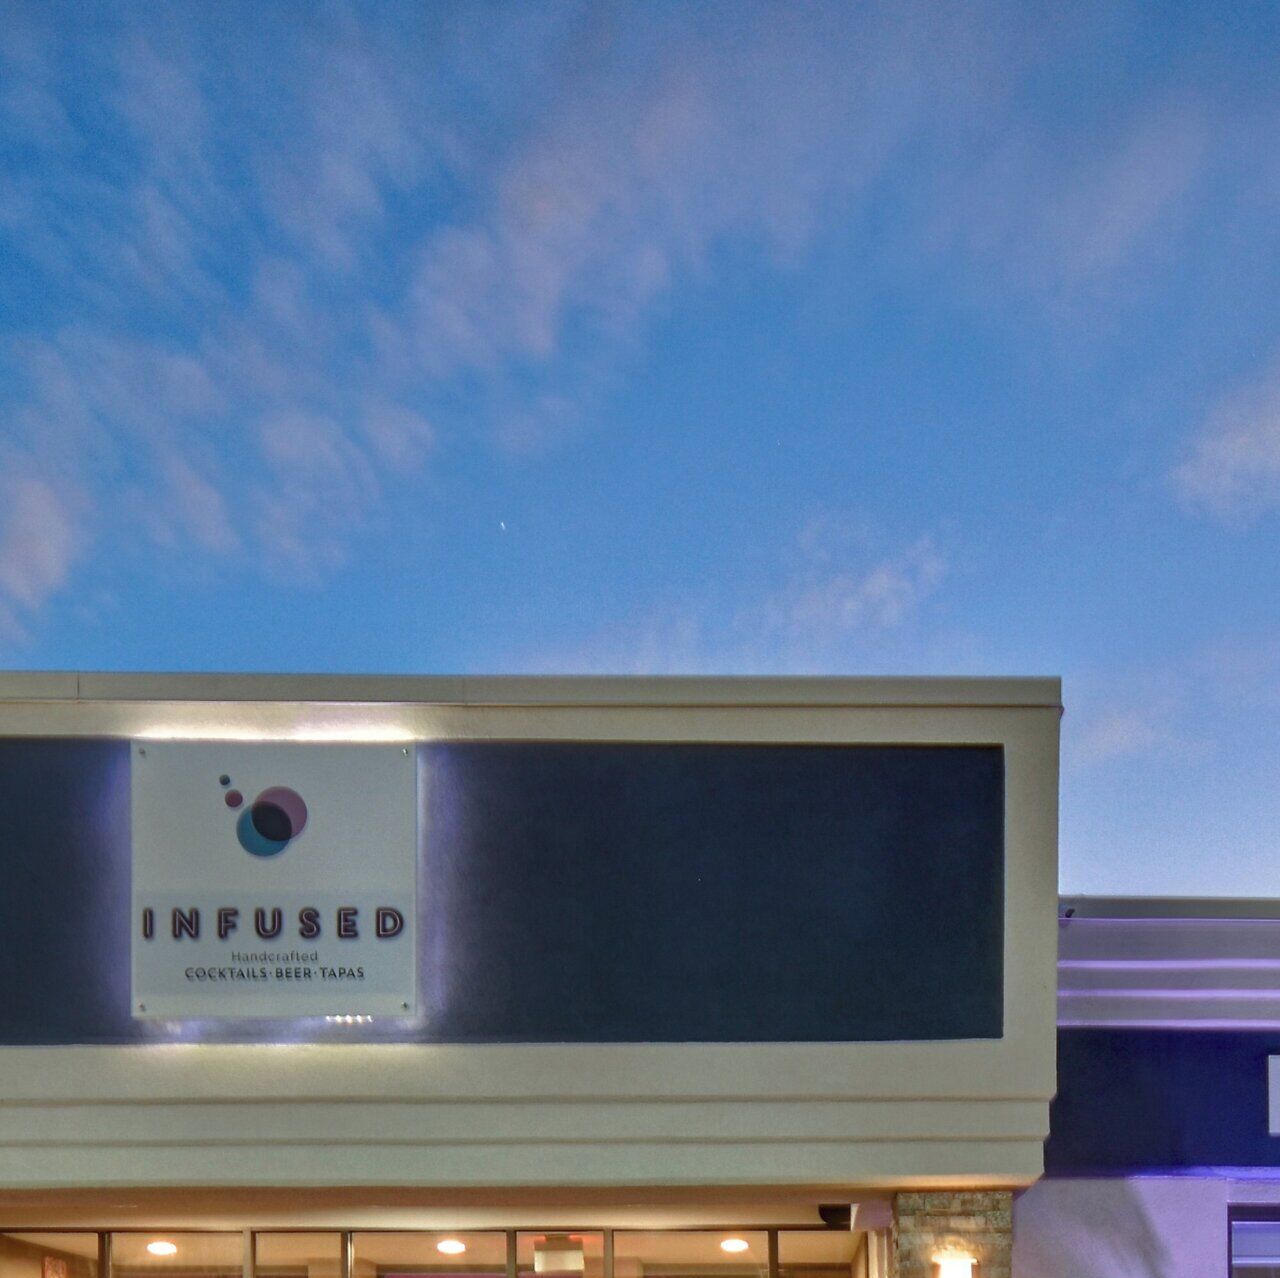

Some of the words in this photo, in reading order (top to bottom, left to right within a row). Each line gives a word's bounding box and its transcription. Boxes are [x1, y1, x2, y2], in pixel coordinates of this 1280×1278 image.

[141, 907, 405, 940] INFUSED
[231, 951, 319, 963] Handcrafted
[184, 966, 268, 981] COCKTAILS
[275, 966, 312, 980] BEER
[319, 966, 365, 979] TAPAS
